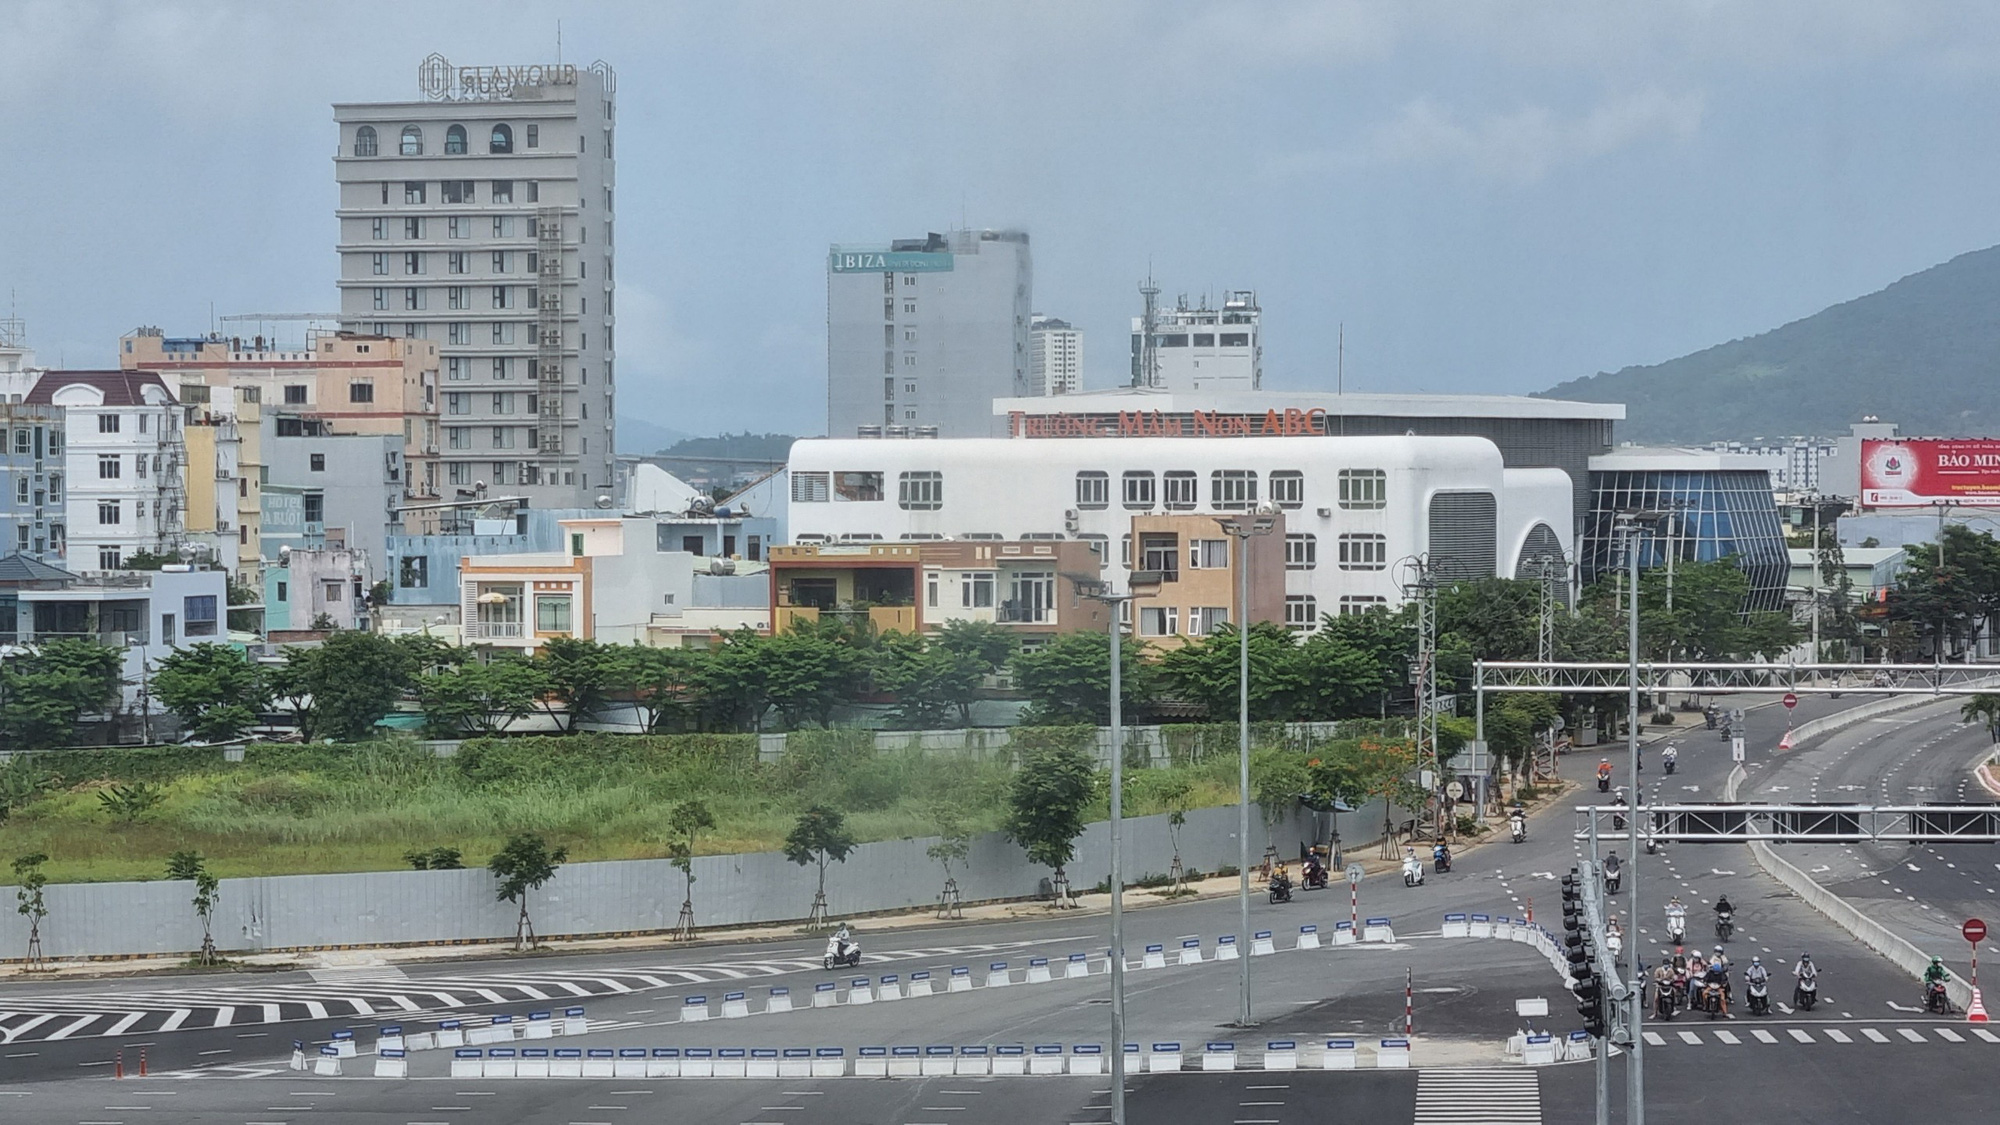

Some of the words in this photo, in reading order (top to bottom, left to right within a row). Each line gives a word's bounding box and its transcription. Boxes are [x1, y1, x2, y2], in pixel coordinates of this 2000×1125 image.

[459, 65, 576, 85] GLAMOUR
[1261, 408, 1326, 436] ABC
[1938, 450, 1970, 467] BẢO
